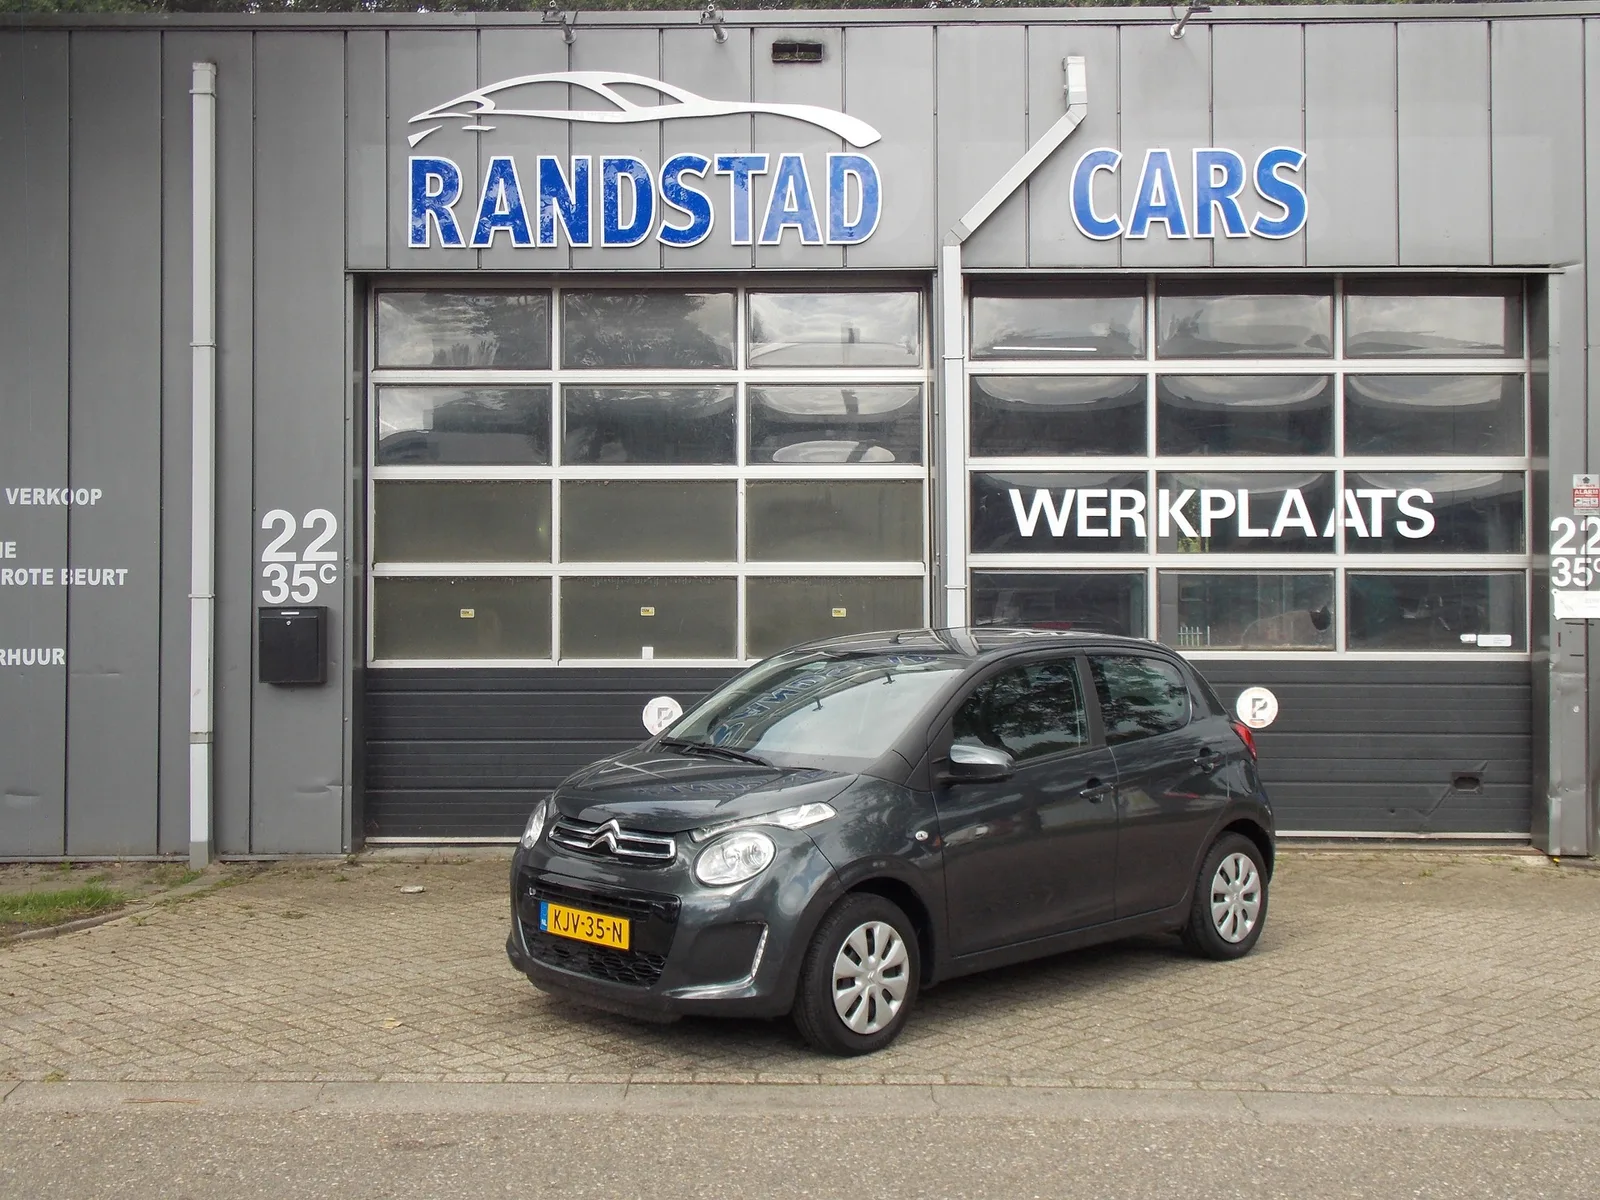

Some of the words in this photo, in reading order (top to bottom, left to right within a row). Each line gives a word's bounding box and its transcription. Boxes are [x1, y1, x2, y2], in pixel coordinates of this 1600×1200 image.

[407, 152, 882, 249] RANDSTAD
[1069, 145, 1308, 241] CARS
[5, 487, 103, 506] VERKOOP
[1008, 487, 1436, 539] WERKPLAATS
[261, 508, 338, 562] 22
[1550, 516, 1600, 555] 22
[60, 568, 128, 586] BEURT
[553, 908, 623, 944] KJV-35-N
